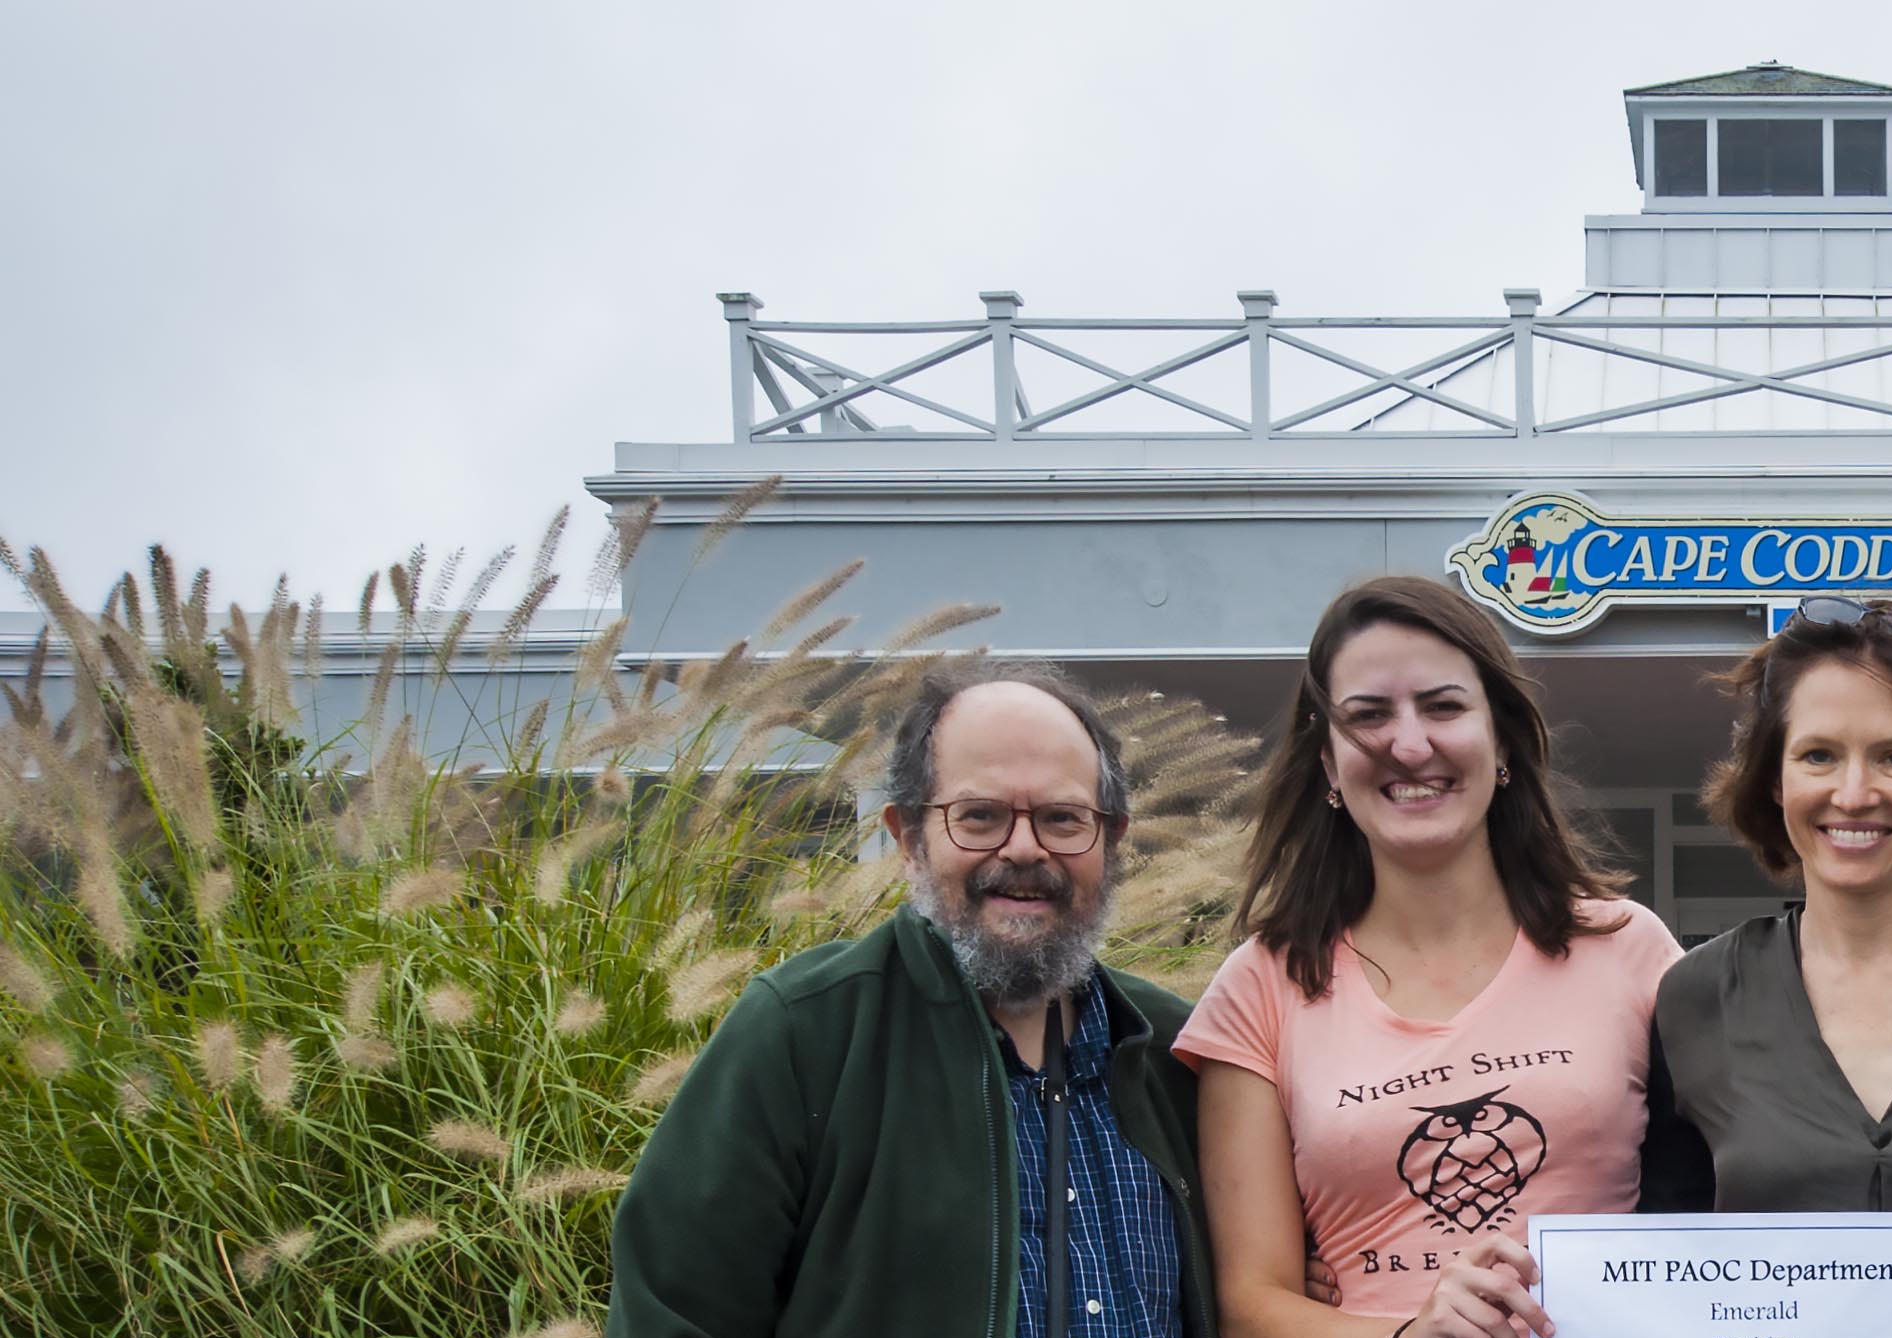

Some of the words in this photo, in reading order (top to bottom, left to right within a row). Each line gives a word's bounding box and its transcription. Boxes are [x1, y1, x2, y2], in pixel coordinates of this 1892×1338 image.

[1572, 529, 1729, 587] CAPE
[1336, 1065, 1454, 1108] NIGHT
[1471, 1050, 1573, 1075] SHIFT
[1601, 1260, 1656, 1283] MIT
[1665, 1260, 1741, 1282] PAOC
[1710, 1300, 1799, 1320] Emerald
